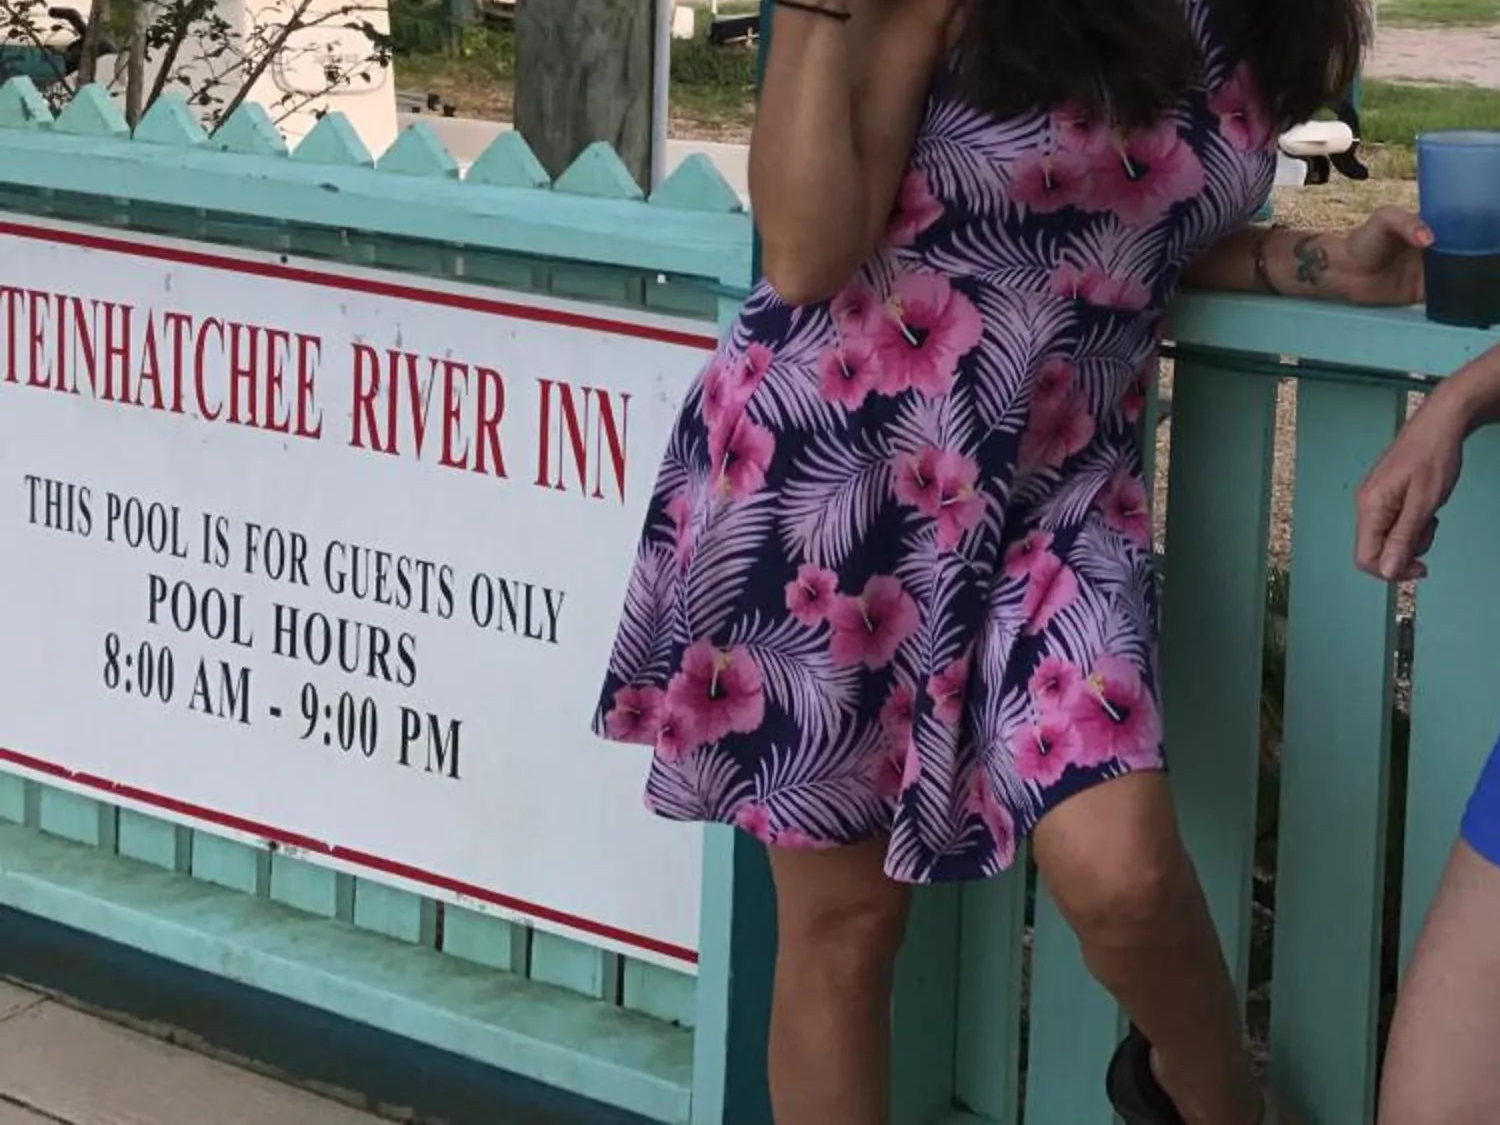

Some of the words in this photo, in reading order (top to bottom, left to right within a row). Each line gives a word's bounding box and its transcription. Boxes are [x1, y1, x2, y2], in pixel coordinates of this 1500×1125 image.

[0, 285, 323, 439] TEINHATCHEE
[349, 343, 508, 479] RIVER
[534, 379, 631, 504] INN
[25, 475, 93, 536] THIS
[106, 493, 188, 559] POOL
[203, 513, 230, 568] IS
[246, 523, 310, 585] FOR
[324, 541, 455, 620] GUESTS
[471, 567, 566, 644] ONLY
[148, 574, 253, 648] POOL
[273, 604, 418, 688] HOURS
[104, 633, 174, 703] 8:00
[189, 659, 251, 725] AM
[270, 707, 282, 717] -
[301, 683, 378, 758] 9:00
[399, 707, 462, 779] PM
